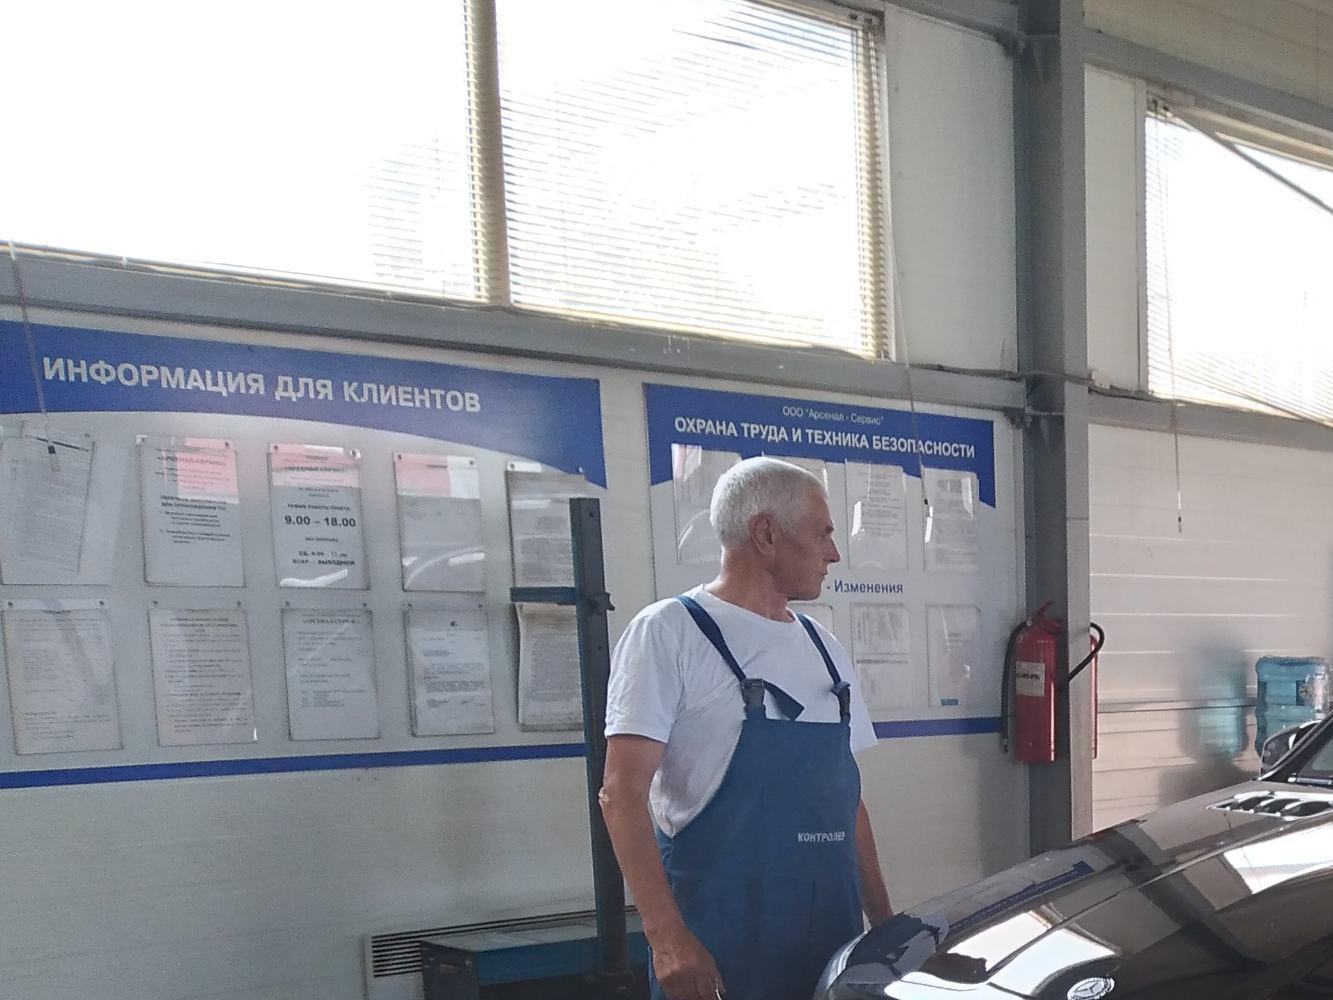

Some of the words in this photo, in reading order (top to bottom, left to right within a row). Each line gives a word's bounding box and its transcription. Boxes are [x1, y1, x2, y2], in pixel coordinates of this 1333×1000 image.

[43, 357, 264, 397] ИНФОРМАЦИЯ
[274, 376, 333, 401] ДЛЯ
[343, 381, 481, 412] КЛИЕНТОВ
[783, 405, 803, 417] ООО
[674, 416, 738, 437] ОХРАНА
[741, 422, 788, 443] ТРУДА
[792, 428, 802, 442] И
[806, 429, 869, 449] ТЕХНИКА
[873, 435, 976, 458] БЕЗОПАСНОСТИ
[284, 515, 311, 525] 9.00
[324, 516, 356, 527] 18.00
[834, 579, 903, 593] Изменения
